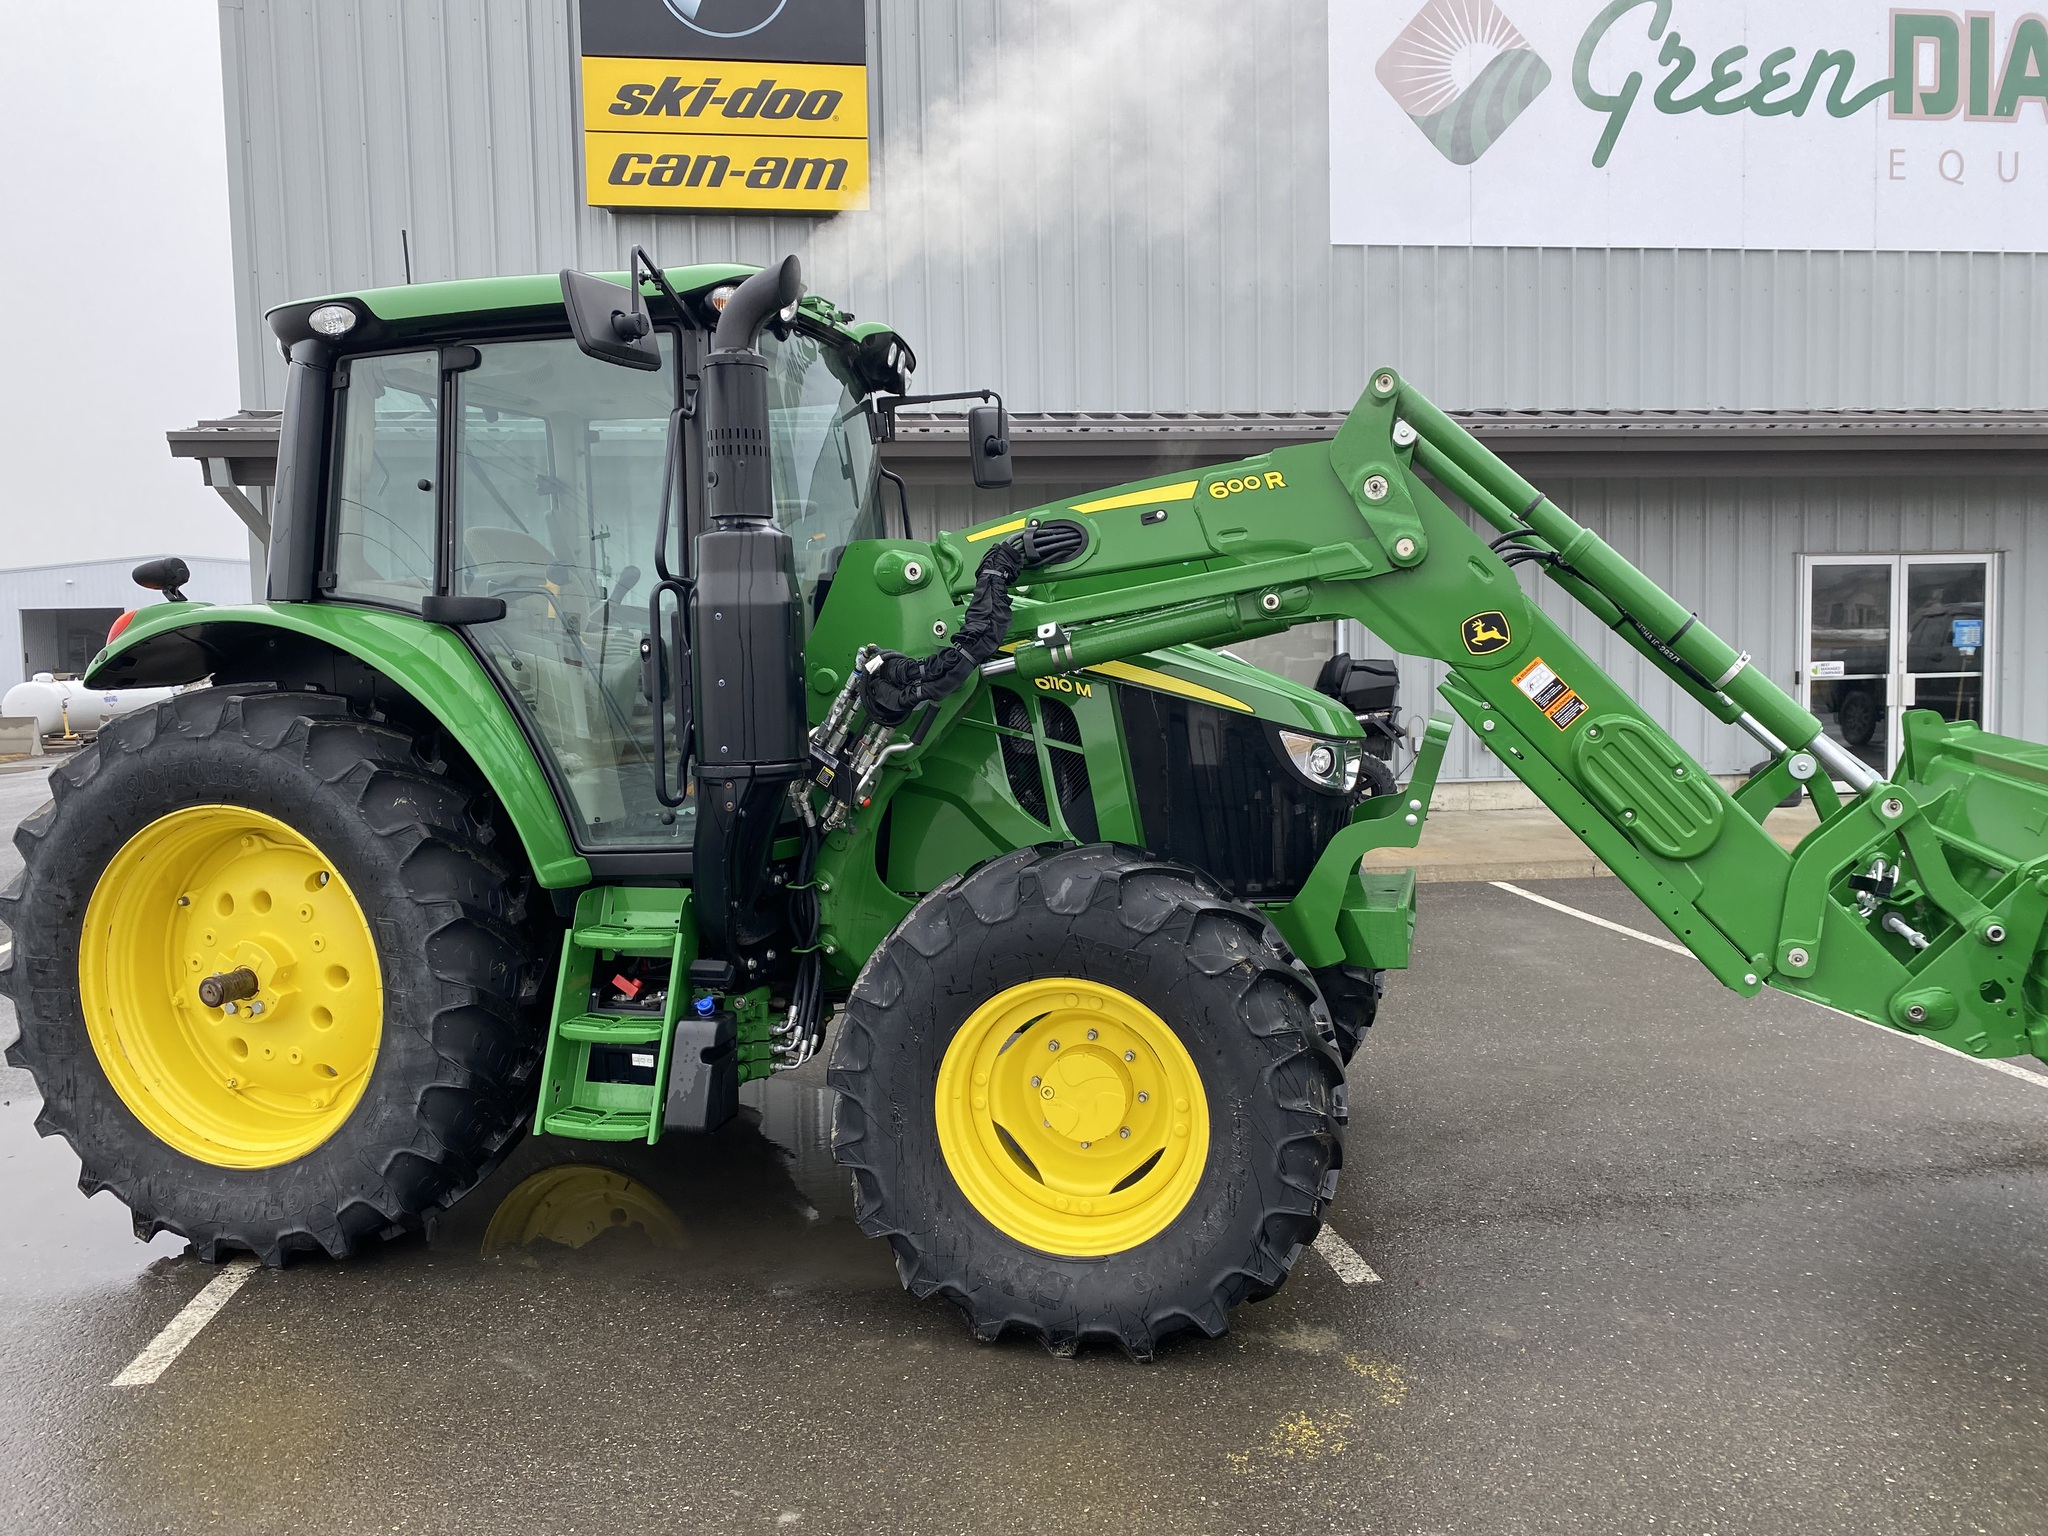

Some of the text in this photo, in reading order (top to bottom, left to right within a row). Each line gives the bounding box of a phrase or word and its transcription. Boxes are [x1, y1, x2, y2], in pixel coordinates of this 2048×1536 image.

[1571, 0, 1890, 168] Green
[1208, 470, 1287, 500] 600 R
[1520, 661, 1539, 678] WARNING
[1074, 681, 1093, 698] M
[1553, 694, 1573, 710] WARNING
